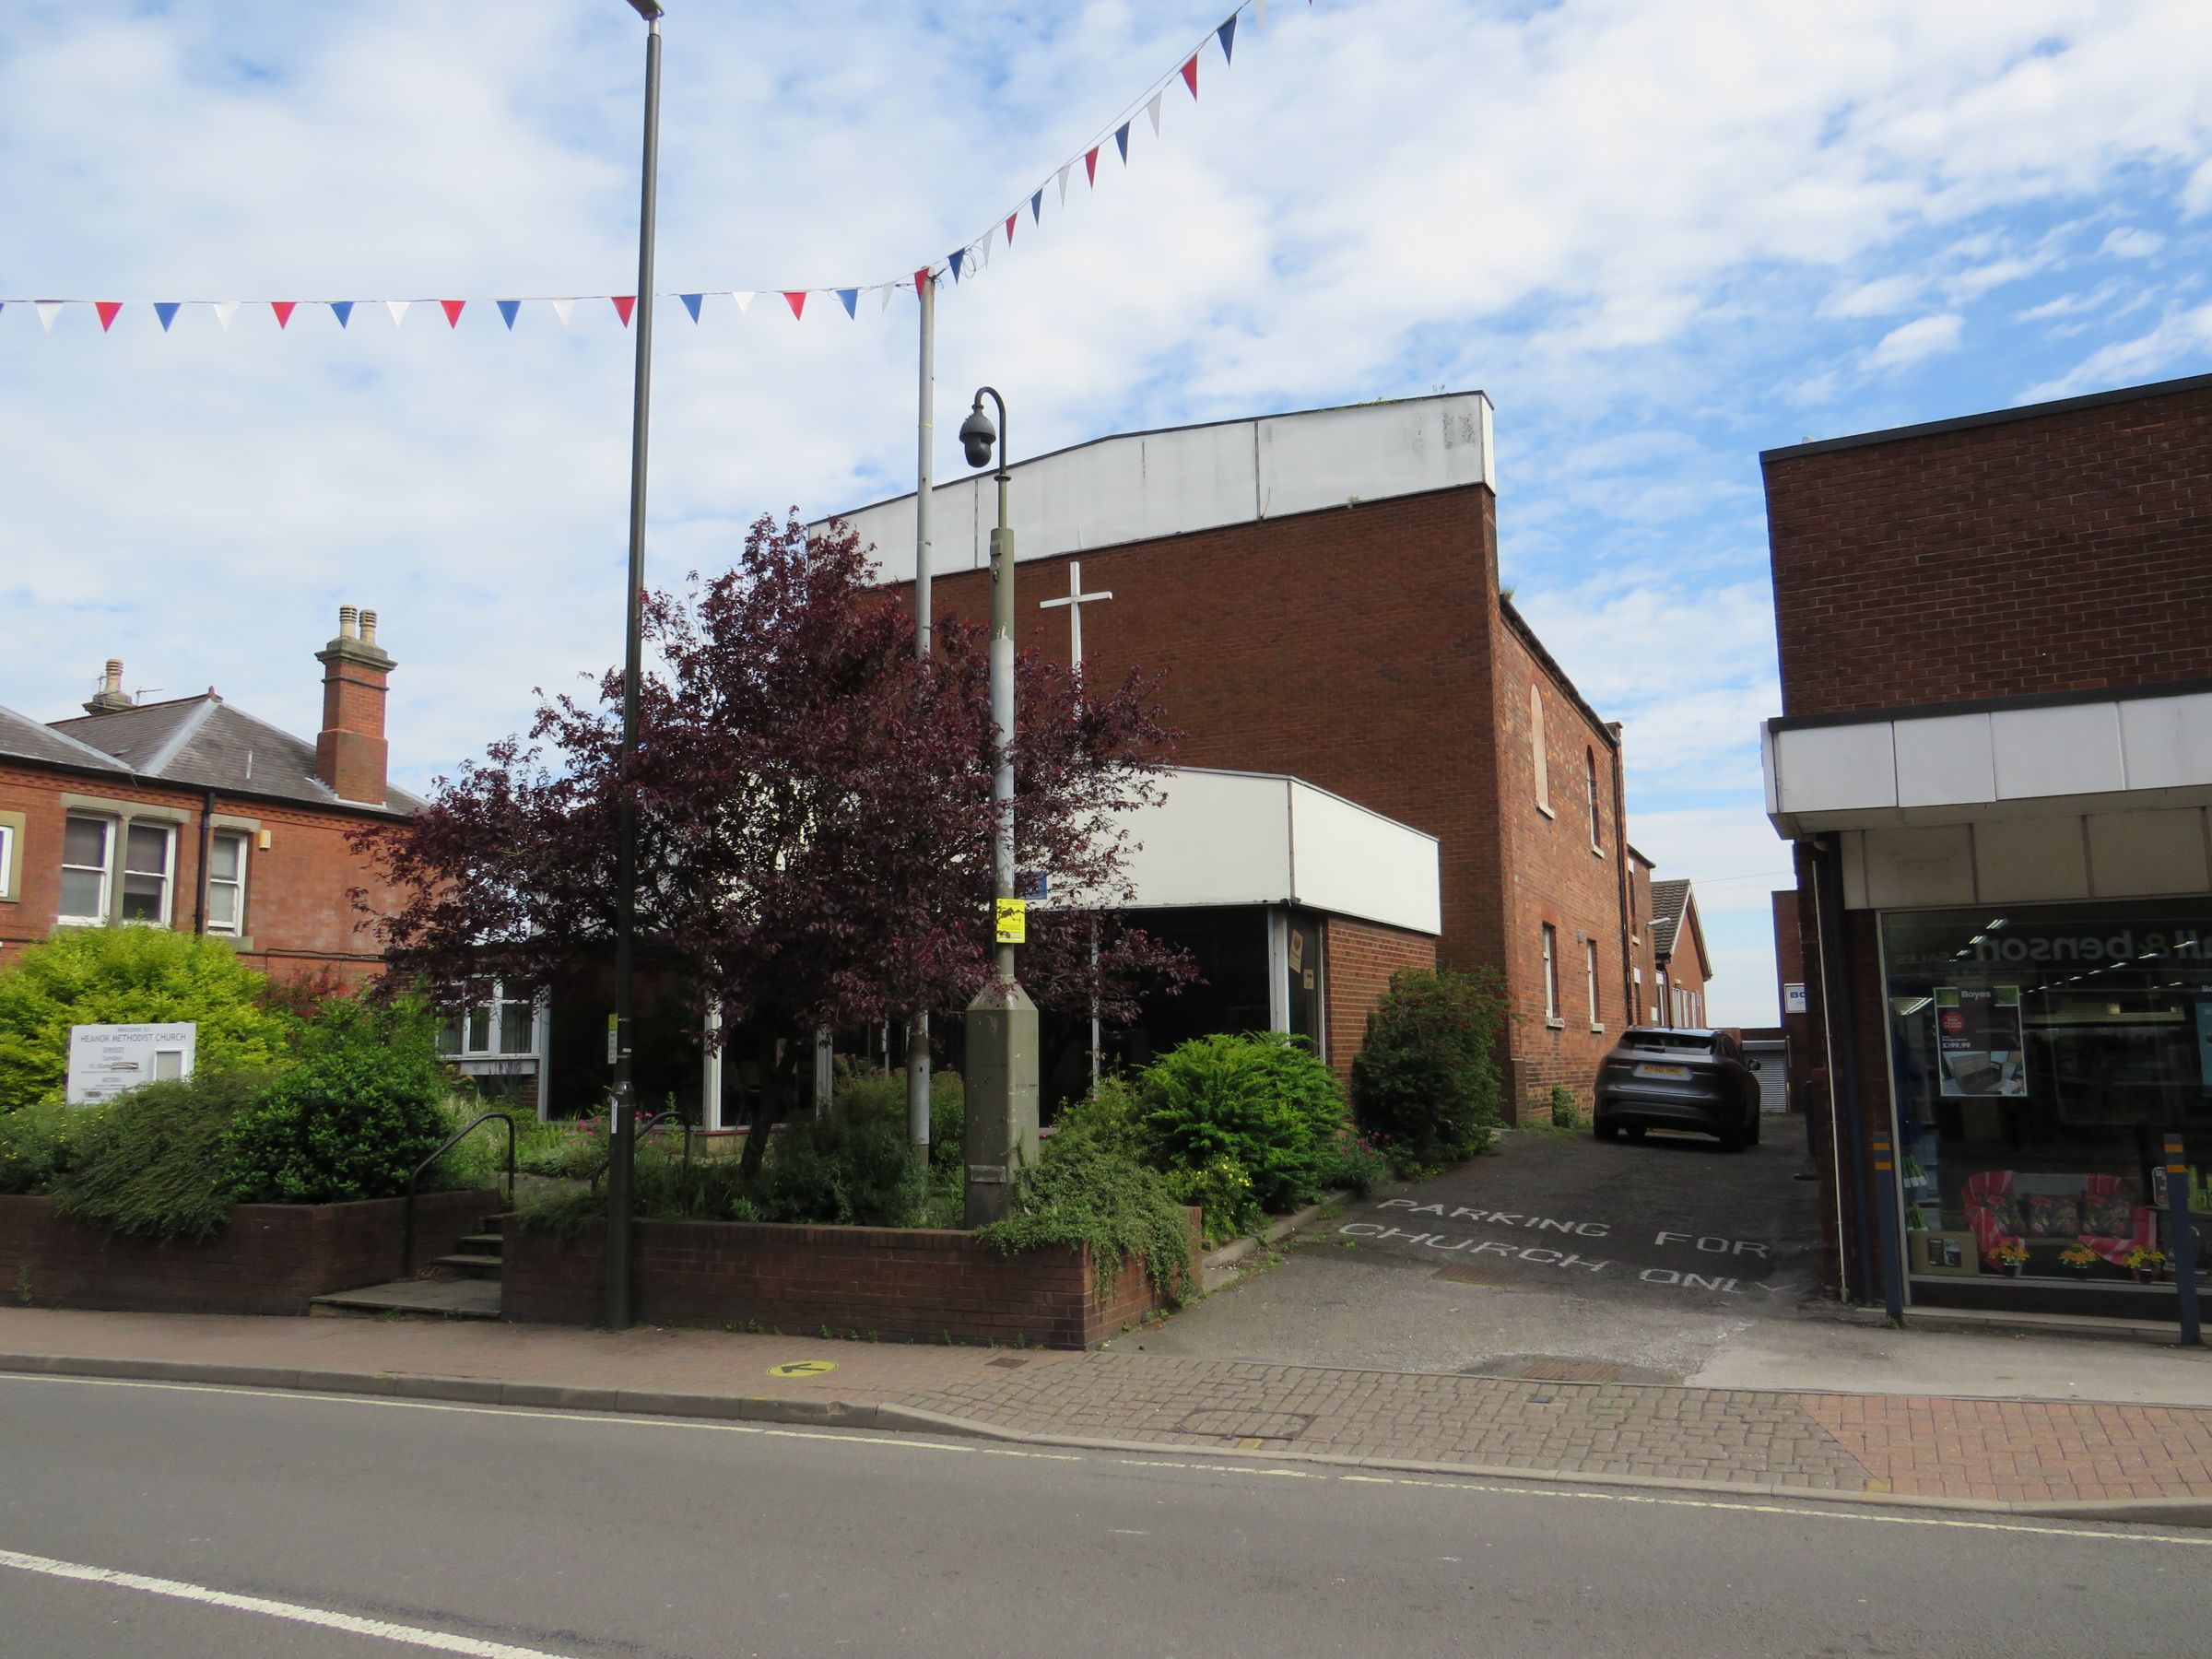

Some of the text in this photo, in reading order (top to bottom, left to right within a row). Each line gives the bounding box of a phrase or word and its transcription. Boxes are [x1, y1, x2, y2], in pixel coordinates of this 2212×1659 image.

[1961, 990, 1991, 1000] Boyes
[81, 1032, 186, 1043] HEANOR METHODIST CHURCH
[1377, 1199, 1771, 1258] PARKING FOR
[1338, 1223, 1612, 1272] CHURCH
